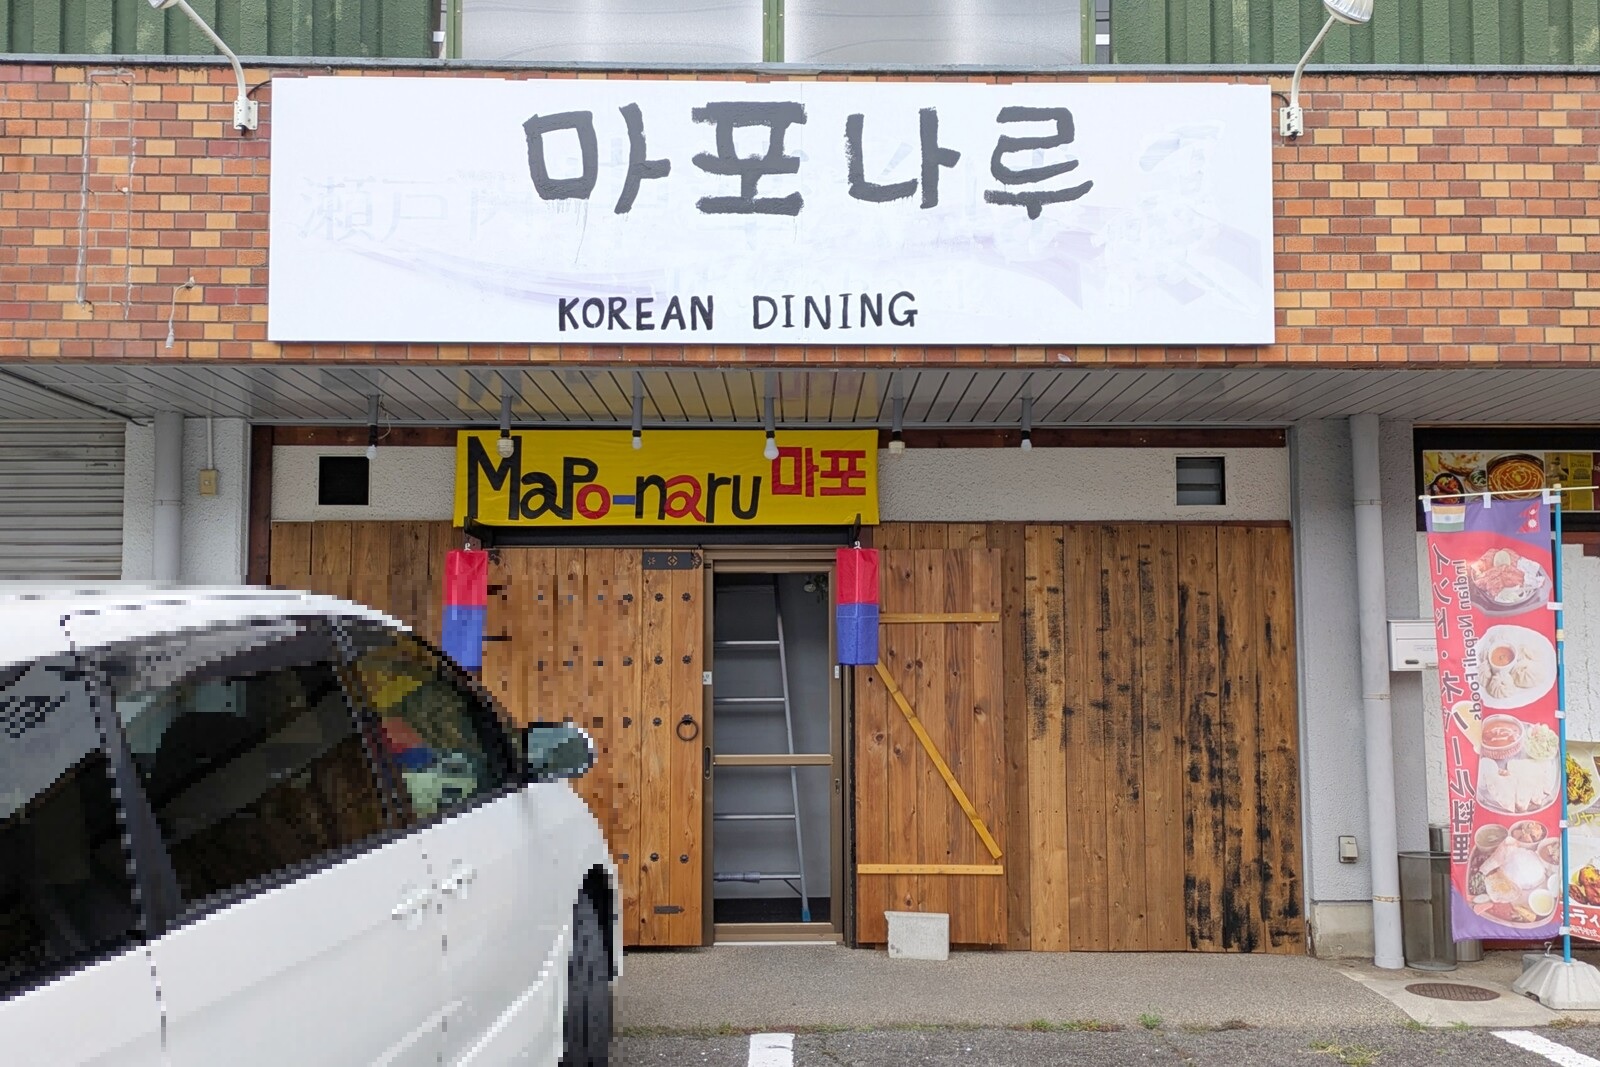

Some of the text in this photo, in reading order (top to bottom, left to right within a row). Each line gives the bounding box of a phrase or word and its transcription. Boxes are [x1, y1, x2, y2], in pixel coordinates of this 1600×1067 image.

[522, 102, 1094, 220] 마포나루
[558, 291, 919, 331] KOREAN DINING
[771, 446, 867, 498] 마포
